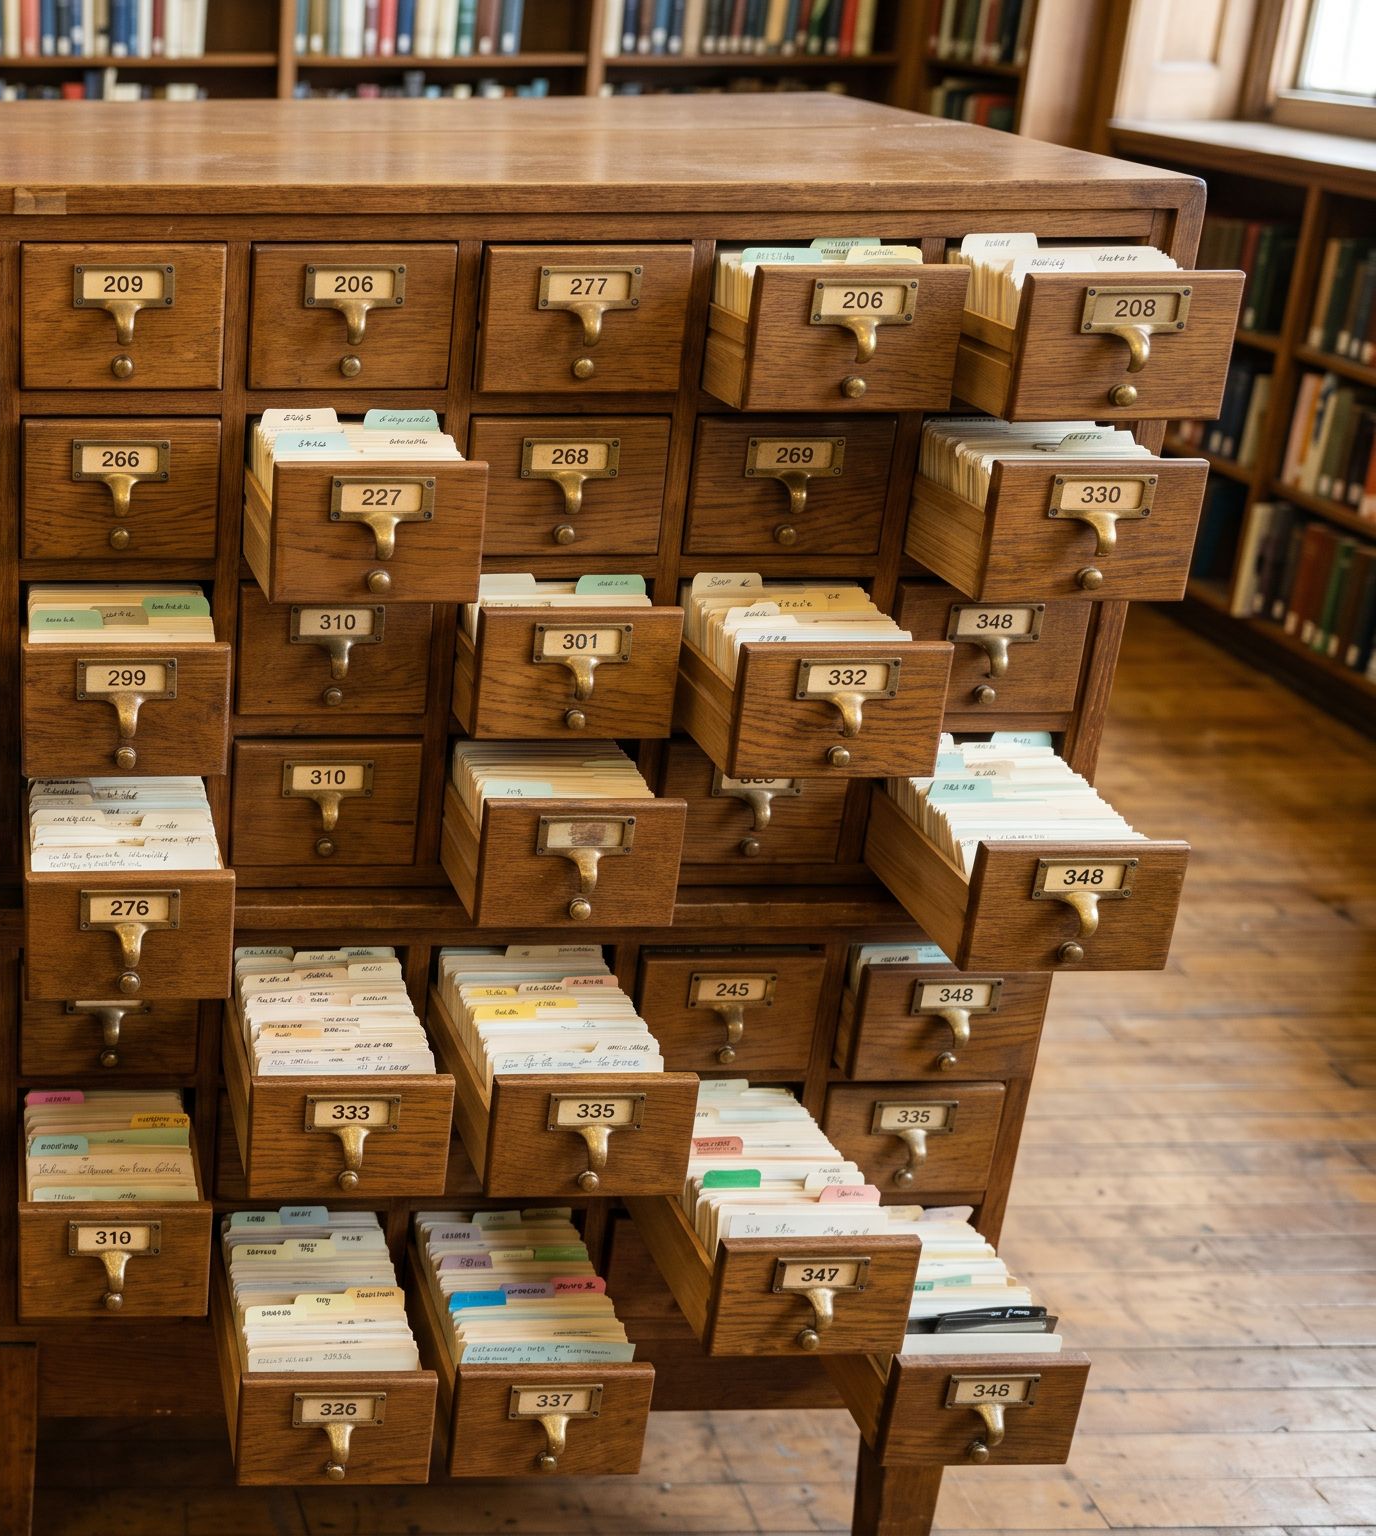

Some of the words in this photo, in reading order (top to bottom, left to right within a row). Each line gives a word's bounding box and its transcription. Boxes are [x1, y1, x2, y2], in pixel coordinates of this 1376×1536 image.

[103, 275, 143, 293] 209
[334, 275, 374, 293] 206
[569, 277, 608, 295] 277
[842, 291, 884, 309] 206
[1114, 298, 1156, 318] 208
[101, 450, 140, 468] 266
[551, 448, 589, 465] 268
[775, 446, 814, 464] 269
[361, 488, 402, 506] 227
[1080, 486, 1121, 504] 330
[319, 614, 356, 631] 310
[975, 613, 1013, 630] 348
[562, 633, 598, 650] 301
[107, 669, 146, 687] 299
[828, 669, 868, 686] 332
[310, 769, 346, 785] 310
[1063, 868, 1104, 886] 348
[110, 899, 150, 916] 276
[715, 982, 749, 997] 245
[939, 988, 974, 1003] 348
[331, 1104, 370, 1121] 333
[576, 1103, 615, 1119] 335
[897, 1110, 931, 1124] 335
[95, 1230, 132, 1245] 310
[801, 1267, 840, 1282] 347
[319, 1402, 357, 1416] 326
[536, 1393, 574, 1408] 337
